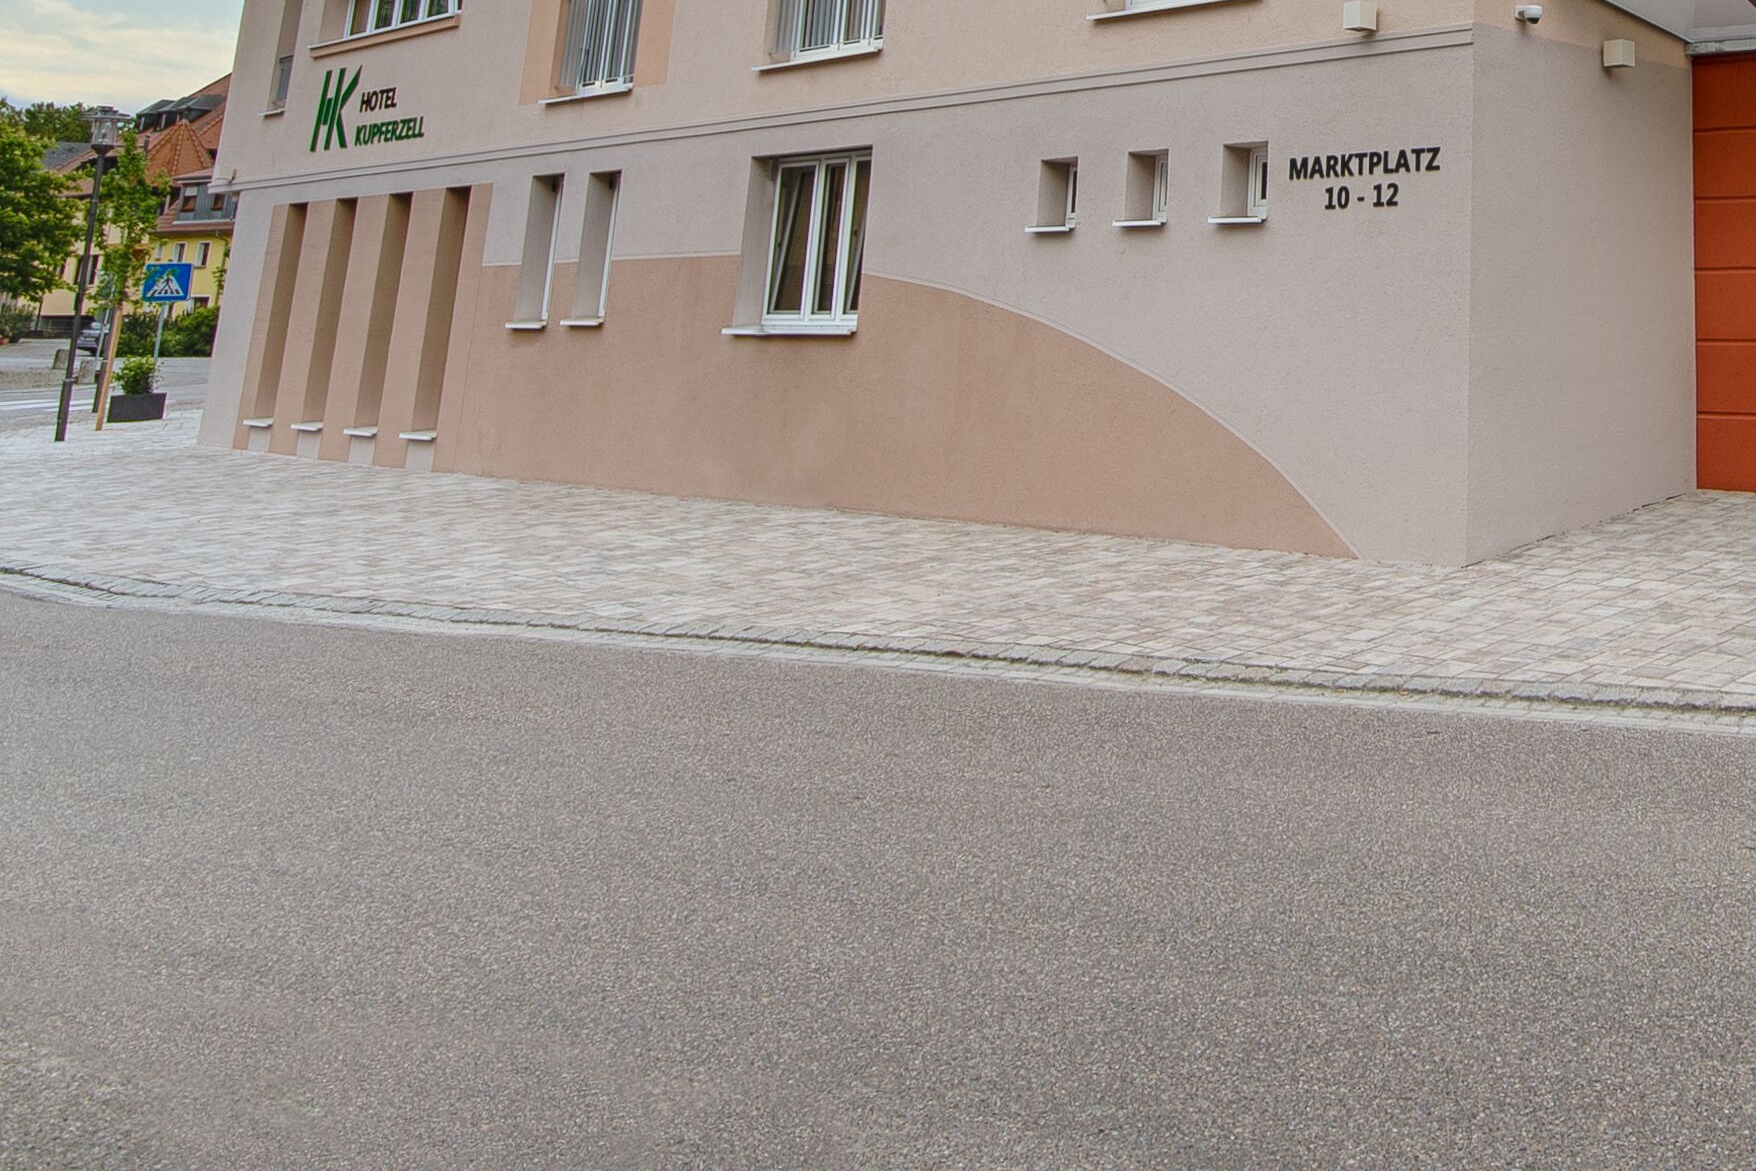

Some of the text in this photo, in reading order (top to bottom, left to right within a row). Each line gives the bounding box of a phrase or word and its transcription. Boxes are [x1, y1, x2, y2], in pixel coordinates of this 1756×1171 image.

[359, 87, 397, 113] HOTEL
[354, 116, 424, 146] KUPFERZELL
[1289, 147, 1441, 180] MARKTPLATZ
[1324, 186, 1350, 210] 10
[1373, 183, 1399, 207] 12
